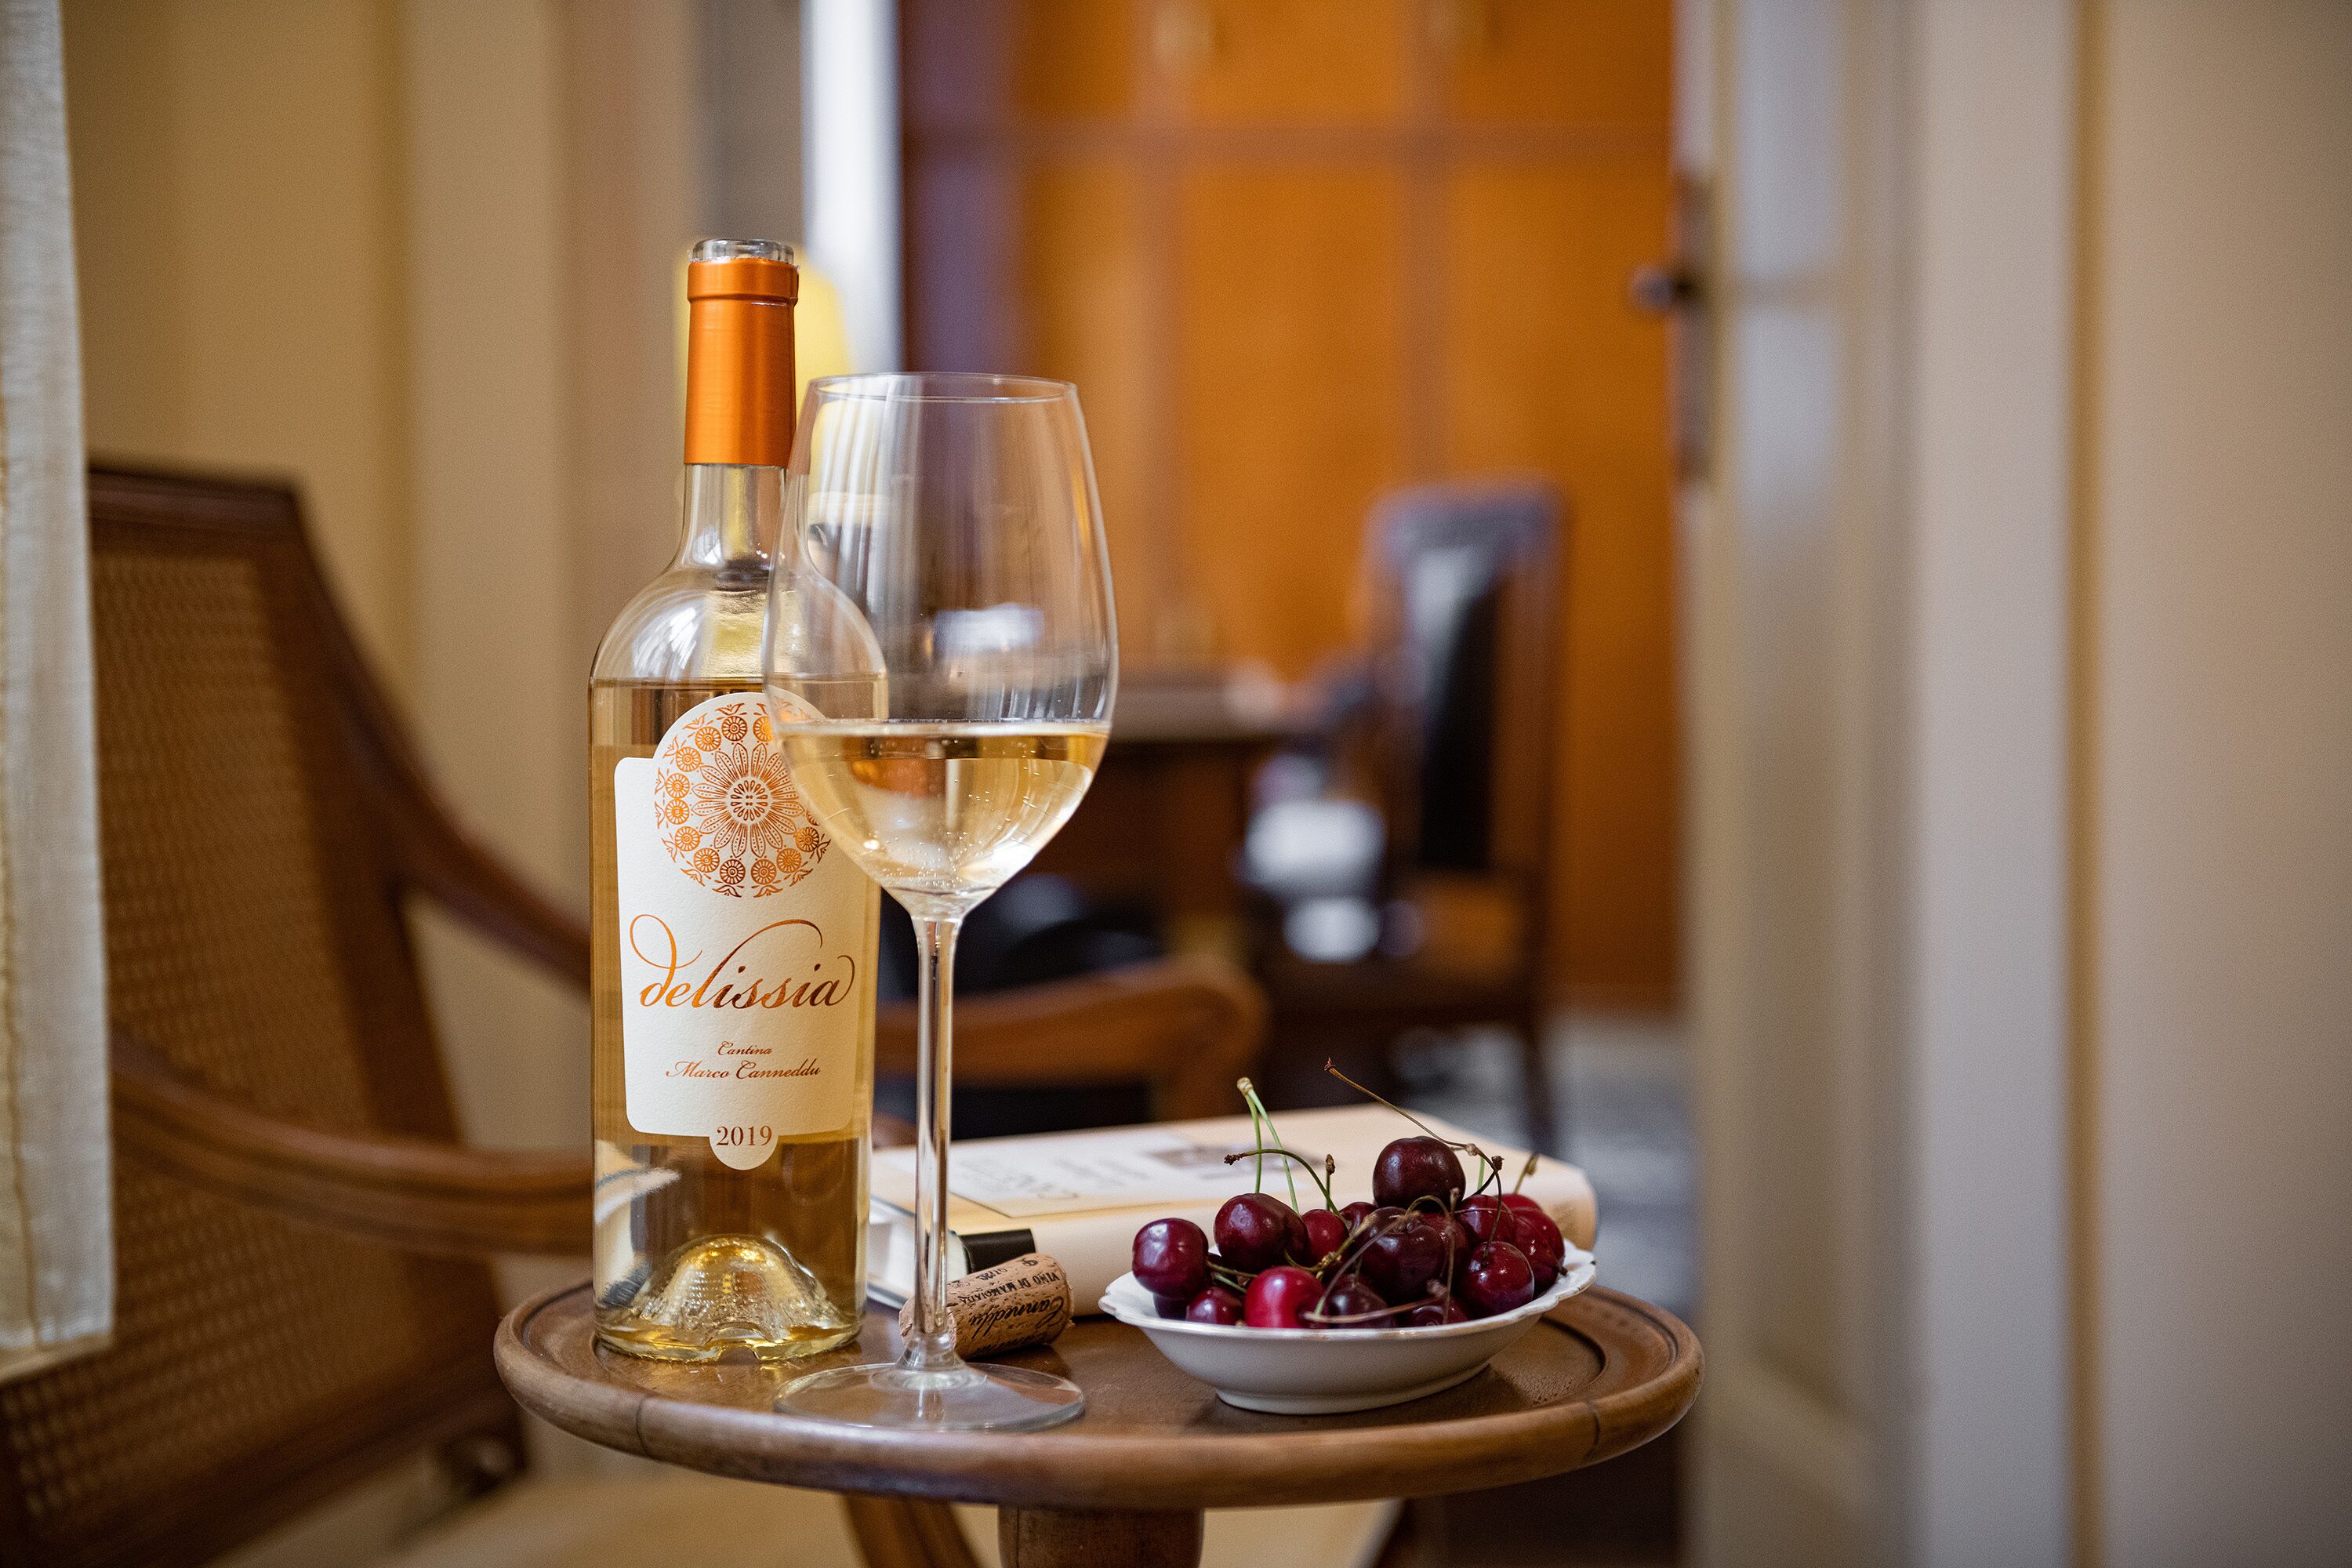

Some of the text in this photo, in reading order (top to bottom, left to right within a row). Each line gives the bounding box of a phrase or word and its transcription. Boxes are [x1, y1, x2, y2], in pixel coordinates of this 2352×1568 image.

[630, 914, 855, 1009] delissia
[717, 1041, 773, 1056] Cantina
[666, 1058, 822, 1080] Marco Canneddu
[716, 1125, 773, 1146] 2019
[1018, 1276, 1032, 1289] DI
[1033, 1272, 1061, 1286] VINO
[968, 1295, 1065, 1340] Canneddu
